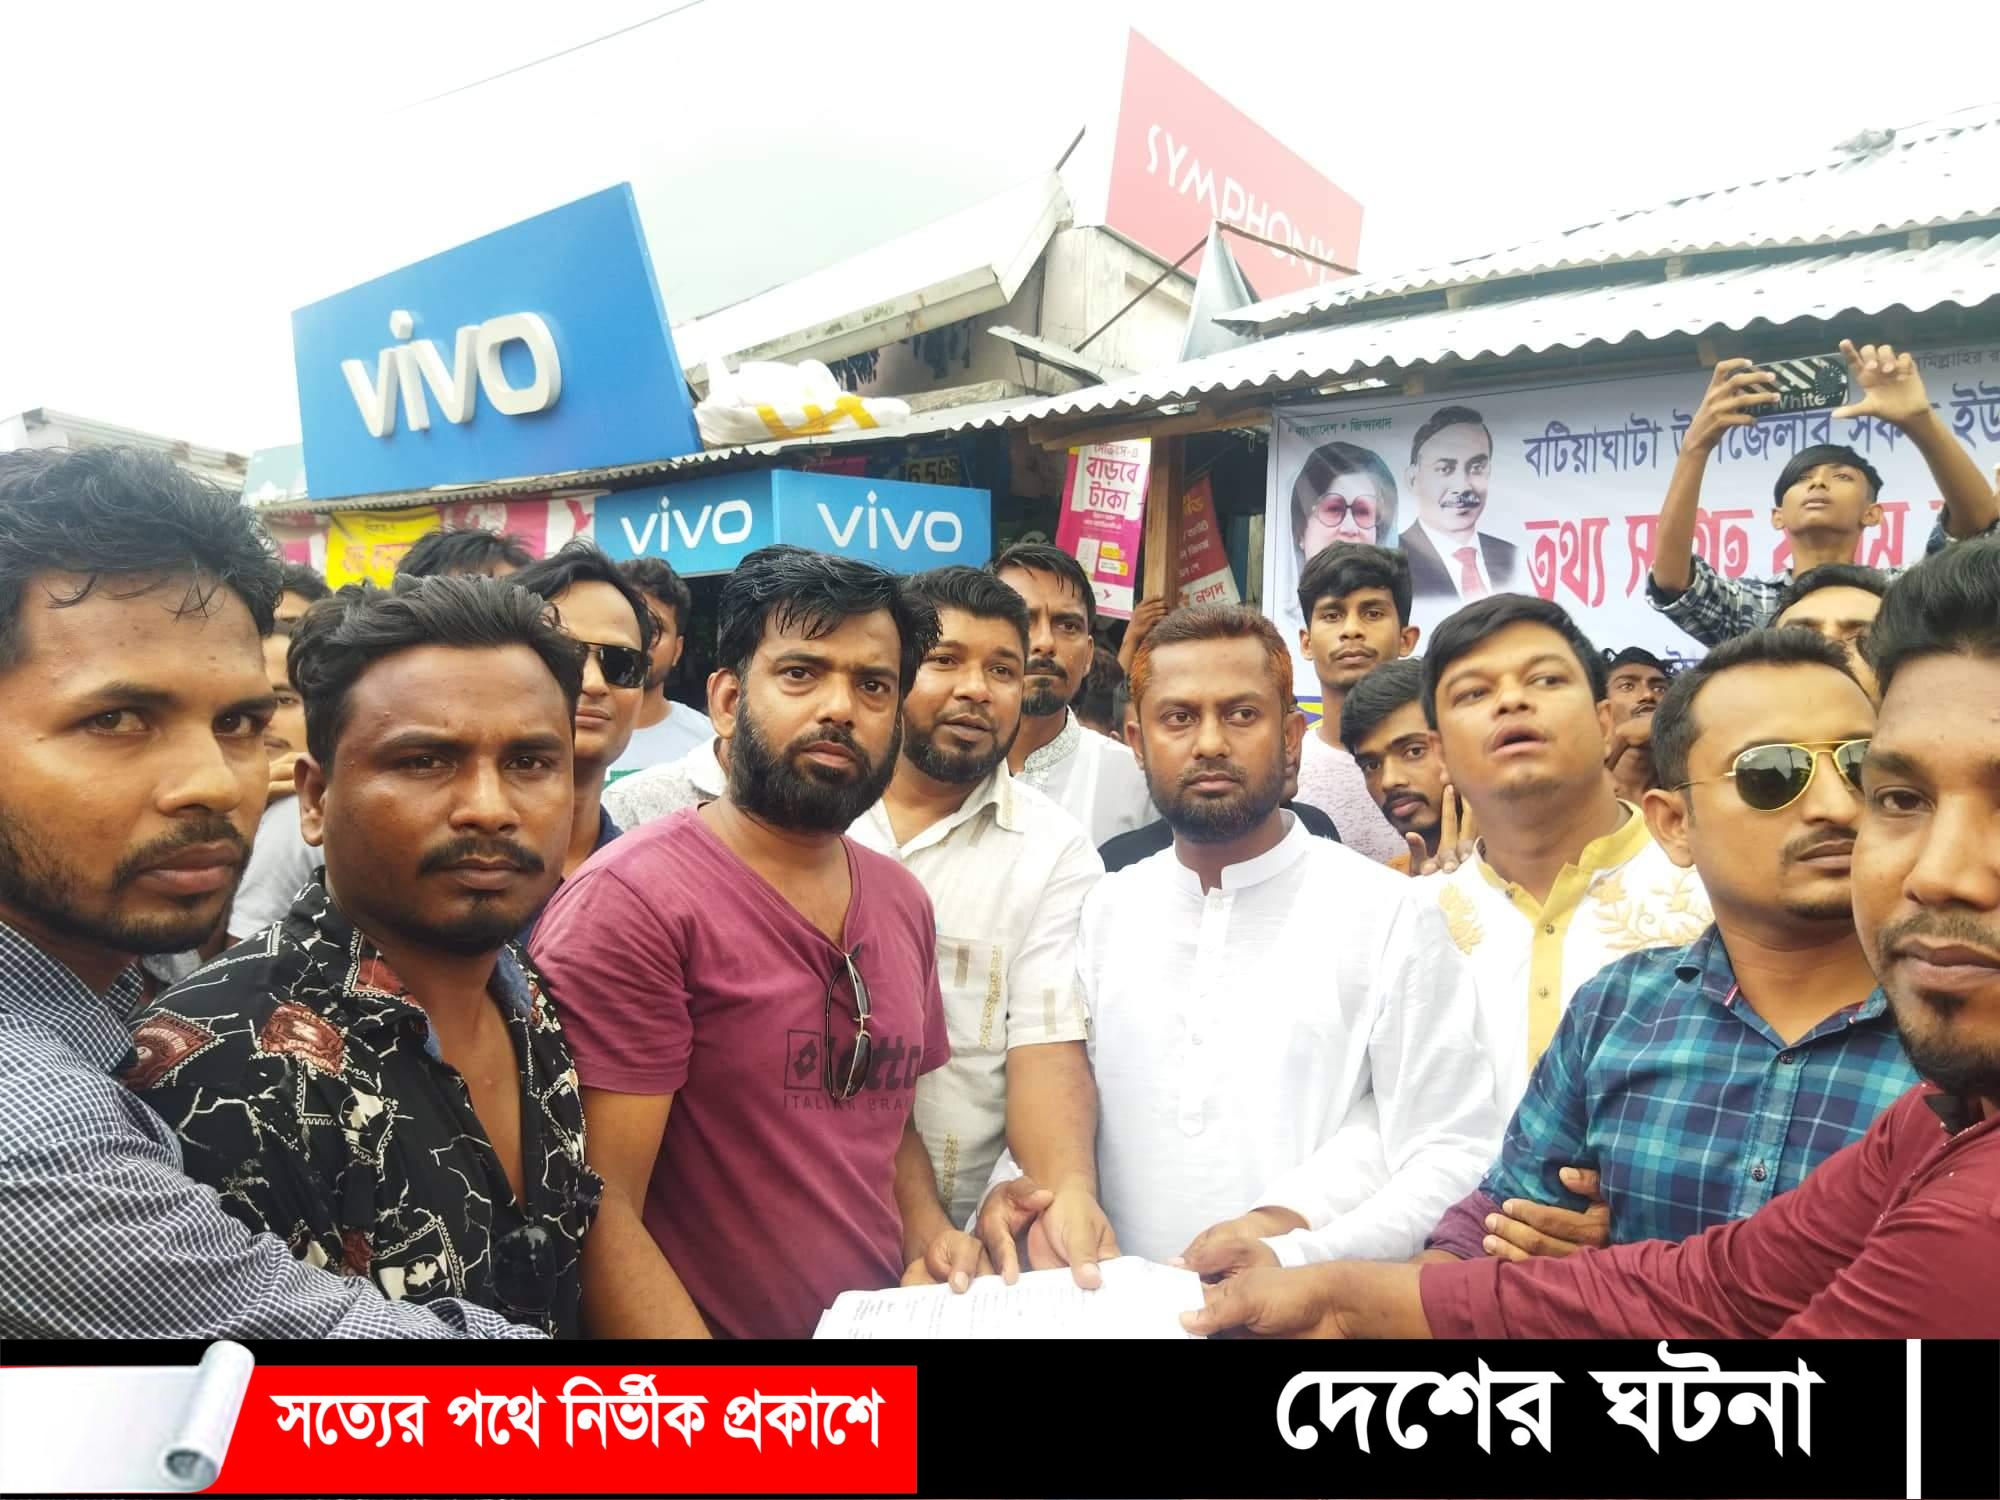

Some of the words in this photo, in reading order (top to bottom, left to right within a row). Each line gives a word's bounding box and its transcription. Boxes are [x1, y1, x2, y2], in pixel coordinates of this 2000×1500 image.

[1146, 124, 1337, 286] SYMPHONY
[341, 310, 562, 438] vivo
[1522, 413, 1664, 478] বটিয়াঘাটা
[620, 496, 753, 555] vivo
[817, 490, 963, 552] vivo
[1088, 481, 1131, 512] টাকা
[1524, 517, 1610, 608] তথ্য
[867, 1097, 908, 1111] BRA
